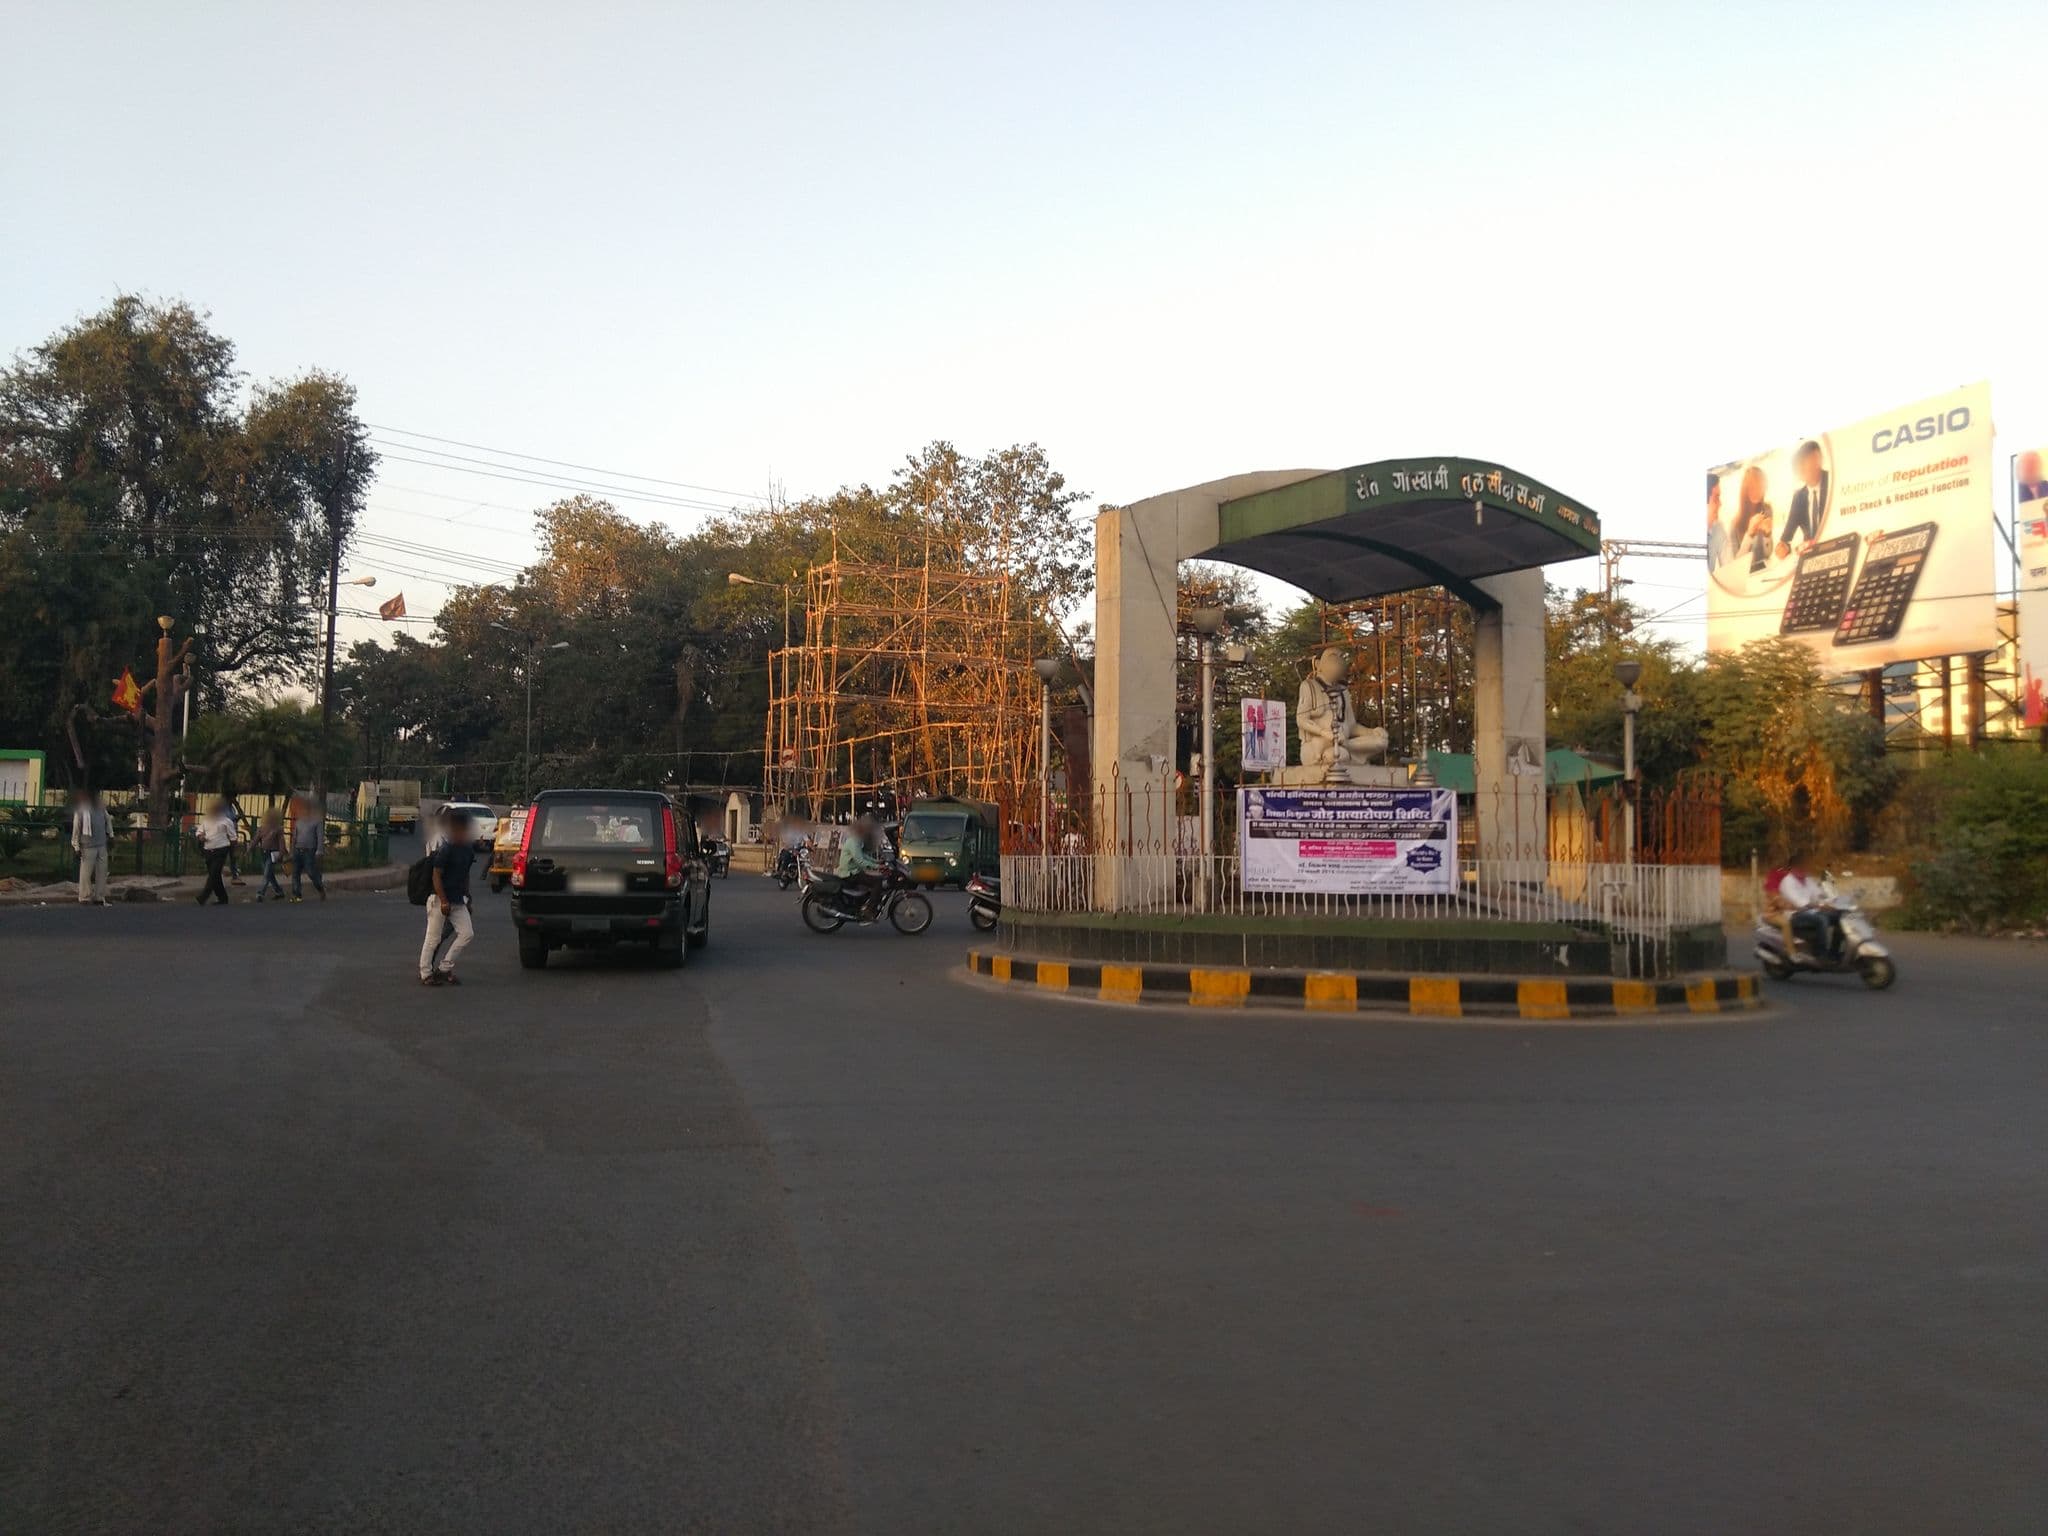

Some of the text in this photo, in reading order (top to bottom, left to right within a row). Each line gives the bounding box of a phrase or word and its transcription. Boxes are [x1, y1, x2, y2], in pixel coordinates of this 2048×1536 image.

[1871, 406, 1970, 454] CASIO
[1892, 454, 1969, 483] Reputation
[1839, 476, 1970, 517] With Check & Recheck Function
[1336, 807, 1394, 820] प्रत्यारोपण
[1395, 807, 1430, 820] शिविर
